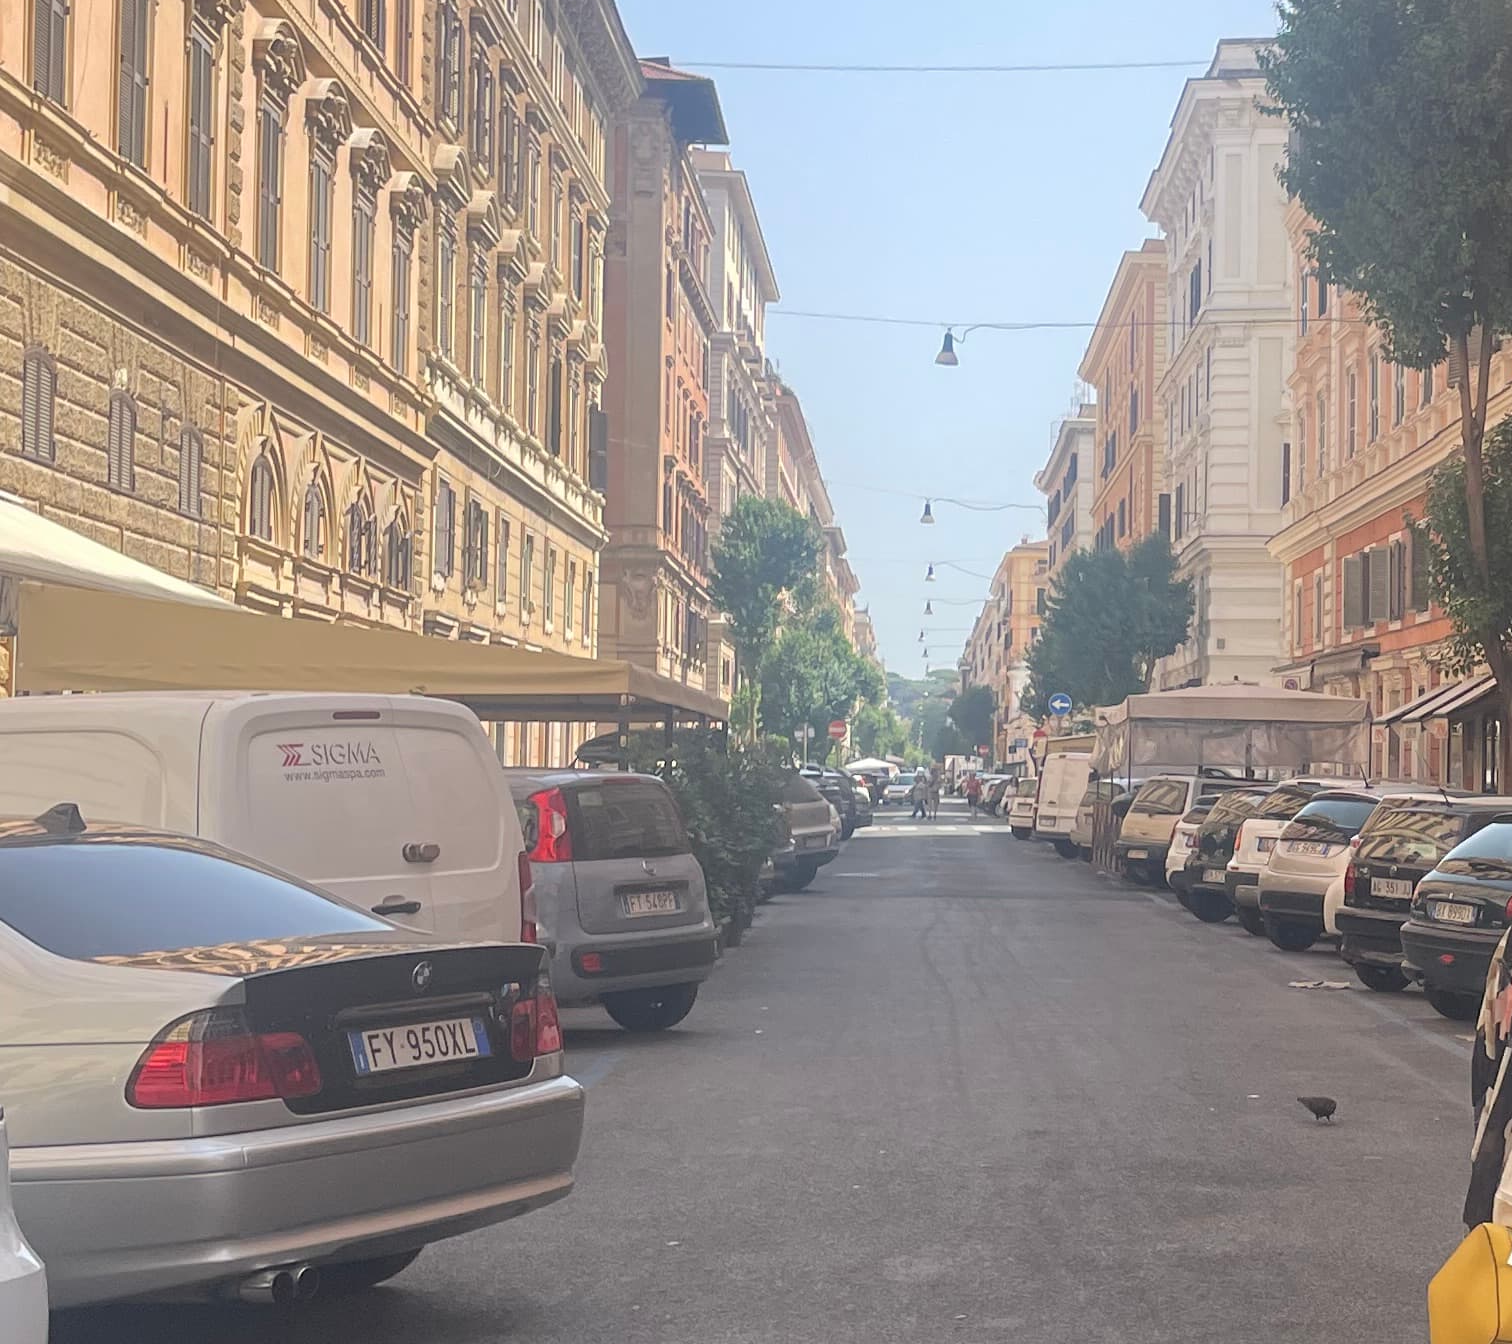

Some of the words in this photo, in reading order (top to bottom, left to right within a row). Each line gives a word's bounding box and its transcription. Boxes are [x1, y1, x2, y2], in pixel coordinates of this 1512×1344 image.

[311, 742, 381, 766] SIGMA
[284, 768, 386, 783] www.sigmaspa.com
[367, 1031, 397, 1068] FY
[406, 1022, 476, 1061] 950XL
